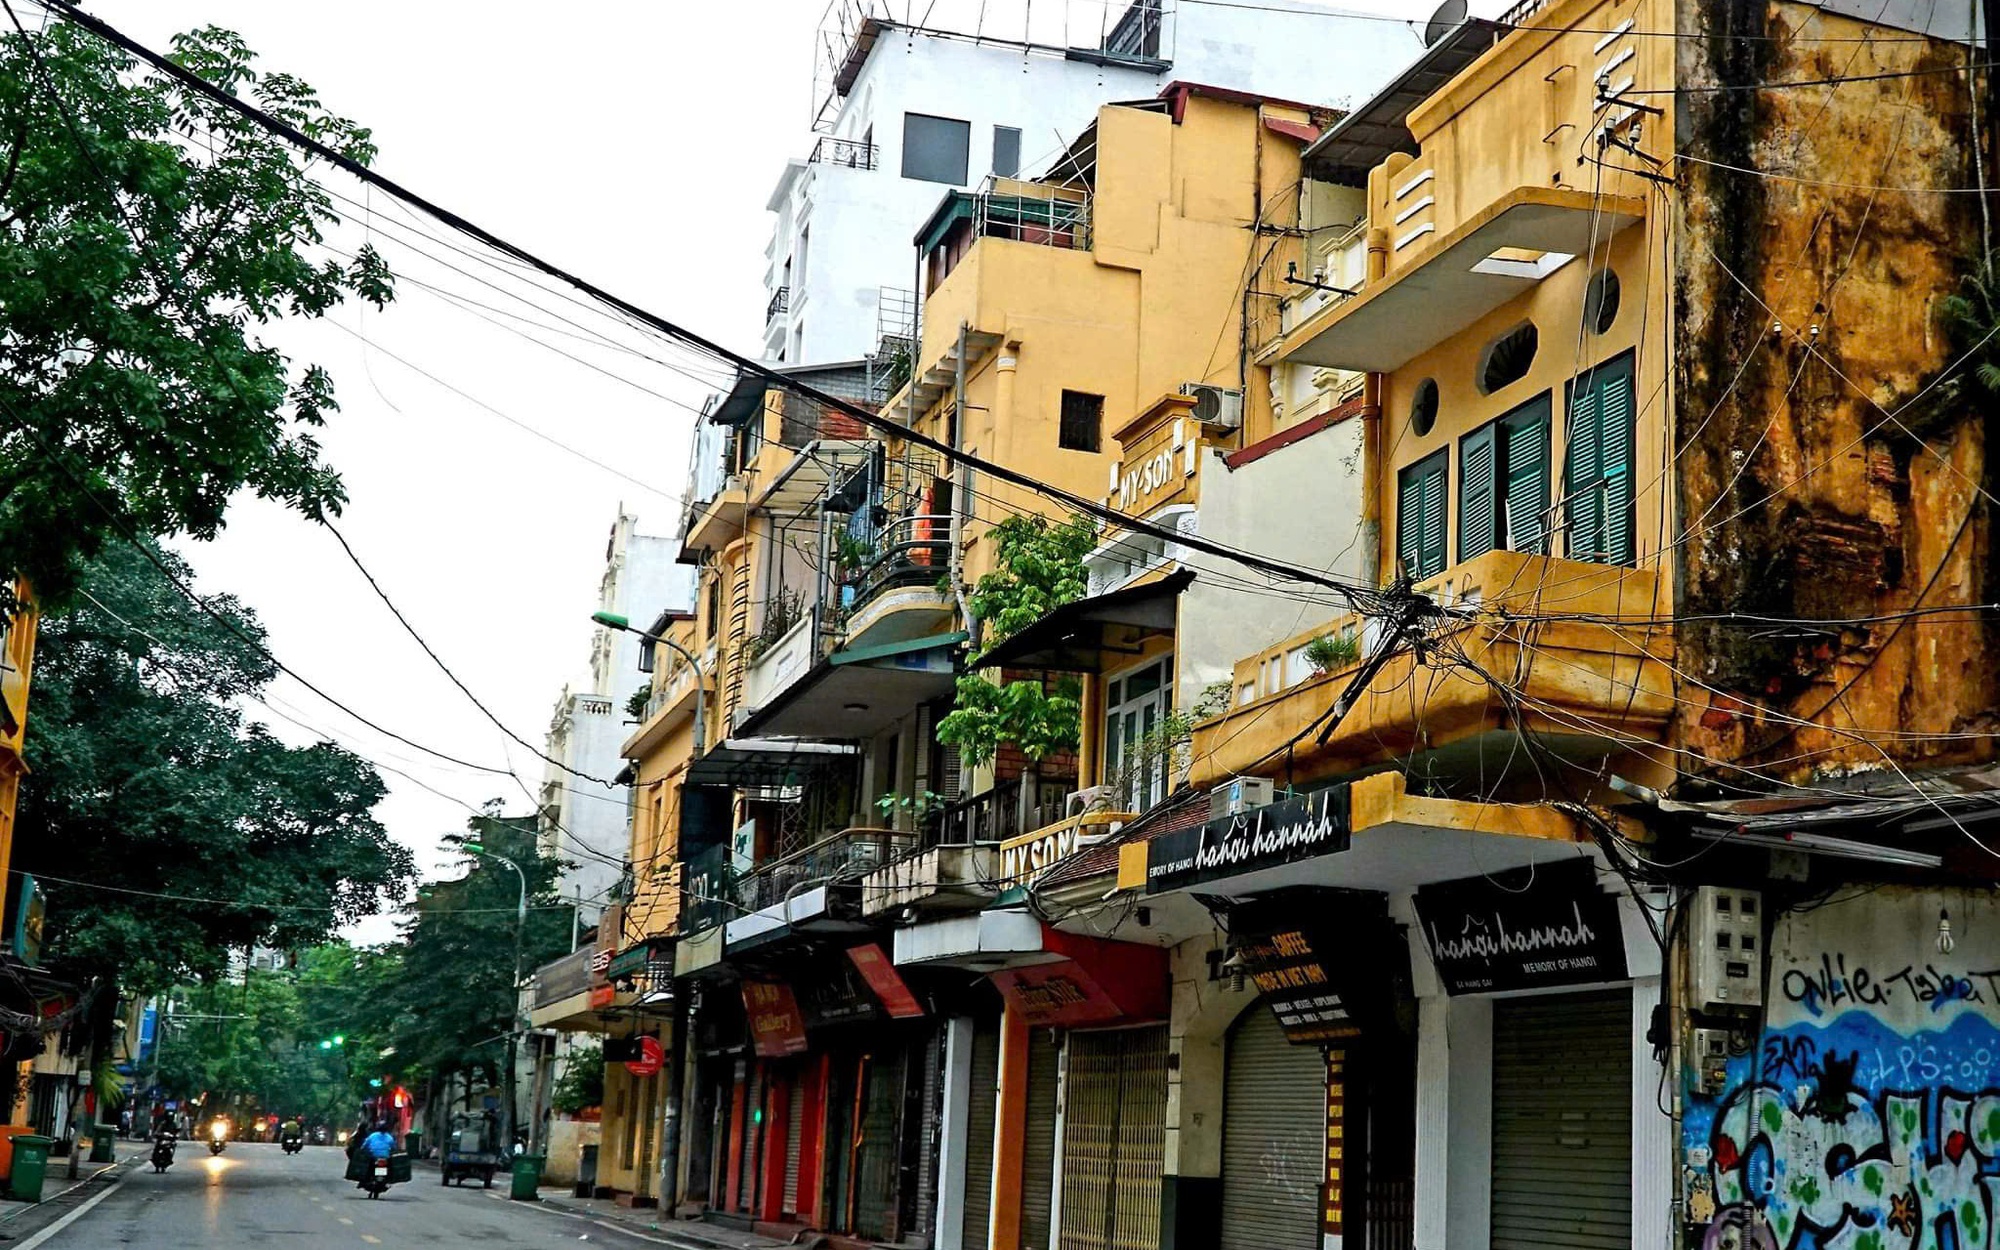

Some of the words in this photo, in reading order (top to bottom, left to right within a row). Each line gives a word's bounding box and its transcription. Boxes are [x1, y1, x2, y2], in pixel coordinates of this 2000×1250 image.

[1252, 791, 1333, 857] hannah
[1167, 862, 1176, 874] OF
[1175, 858, 1193, 872] HANOI
[1496, 901, 1595, 953] hannah
[1271, 931, 1312, 957] COFFEE
[1522, 960, 1557, 974] MEMORY
[1557, 958, 1569, 971] OF
[1569, 955, 1597, 969] HANOI
